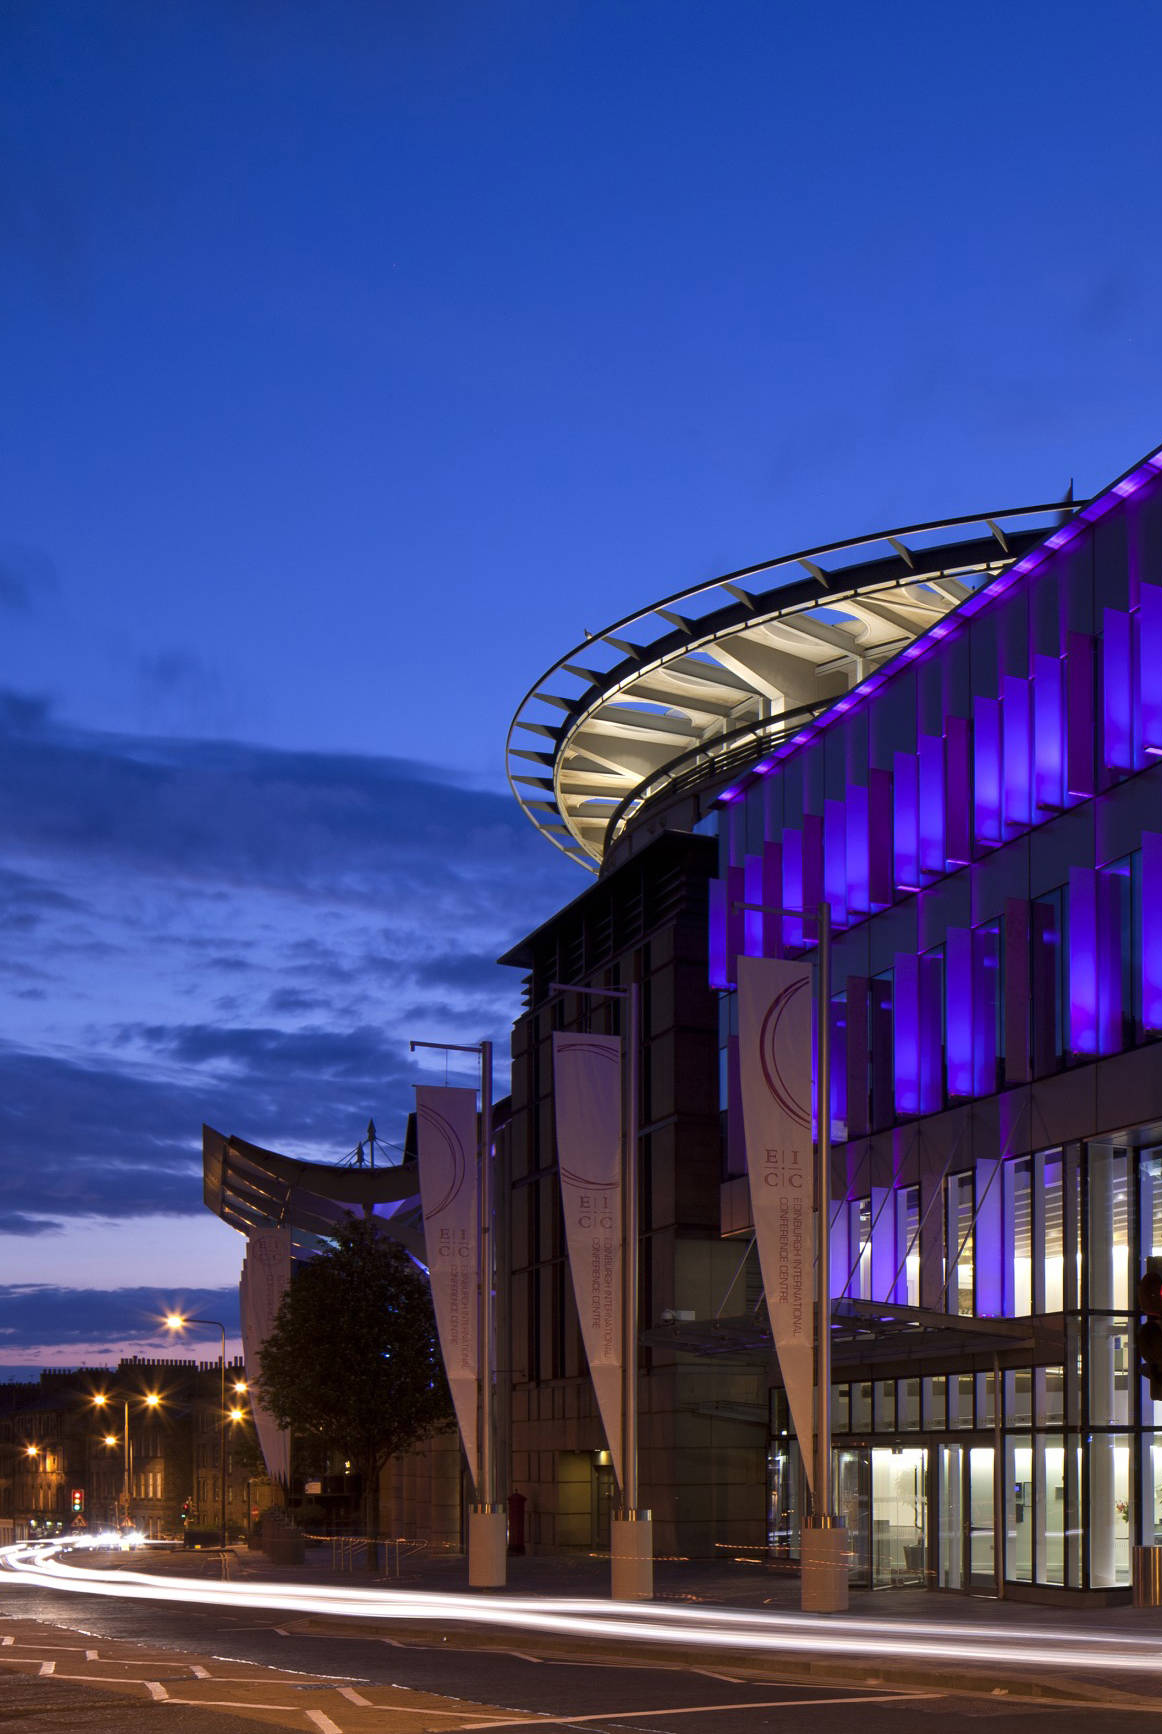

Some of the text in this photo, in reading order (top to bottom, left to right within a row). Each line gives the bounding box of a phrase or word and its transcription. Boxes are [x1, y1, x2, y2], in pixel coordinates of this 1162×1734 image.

[778, 1196, 789, 1305] CONFERENCE CENTRE
[791, 1197, 803, 1337] EDINBURGH INTERNATIONAL
